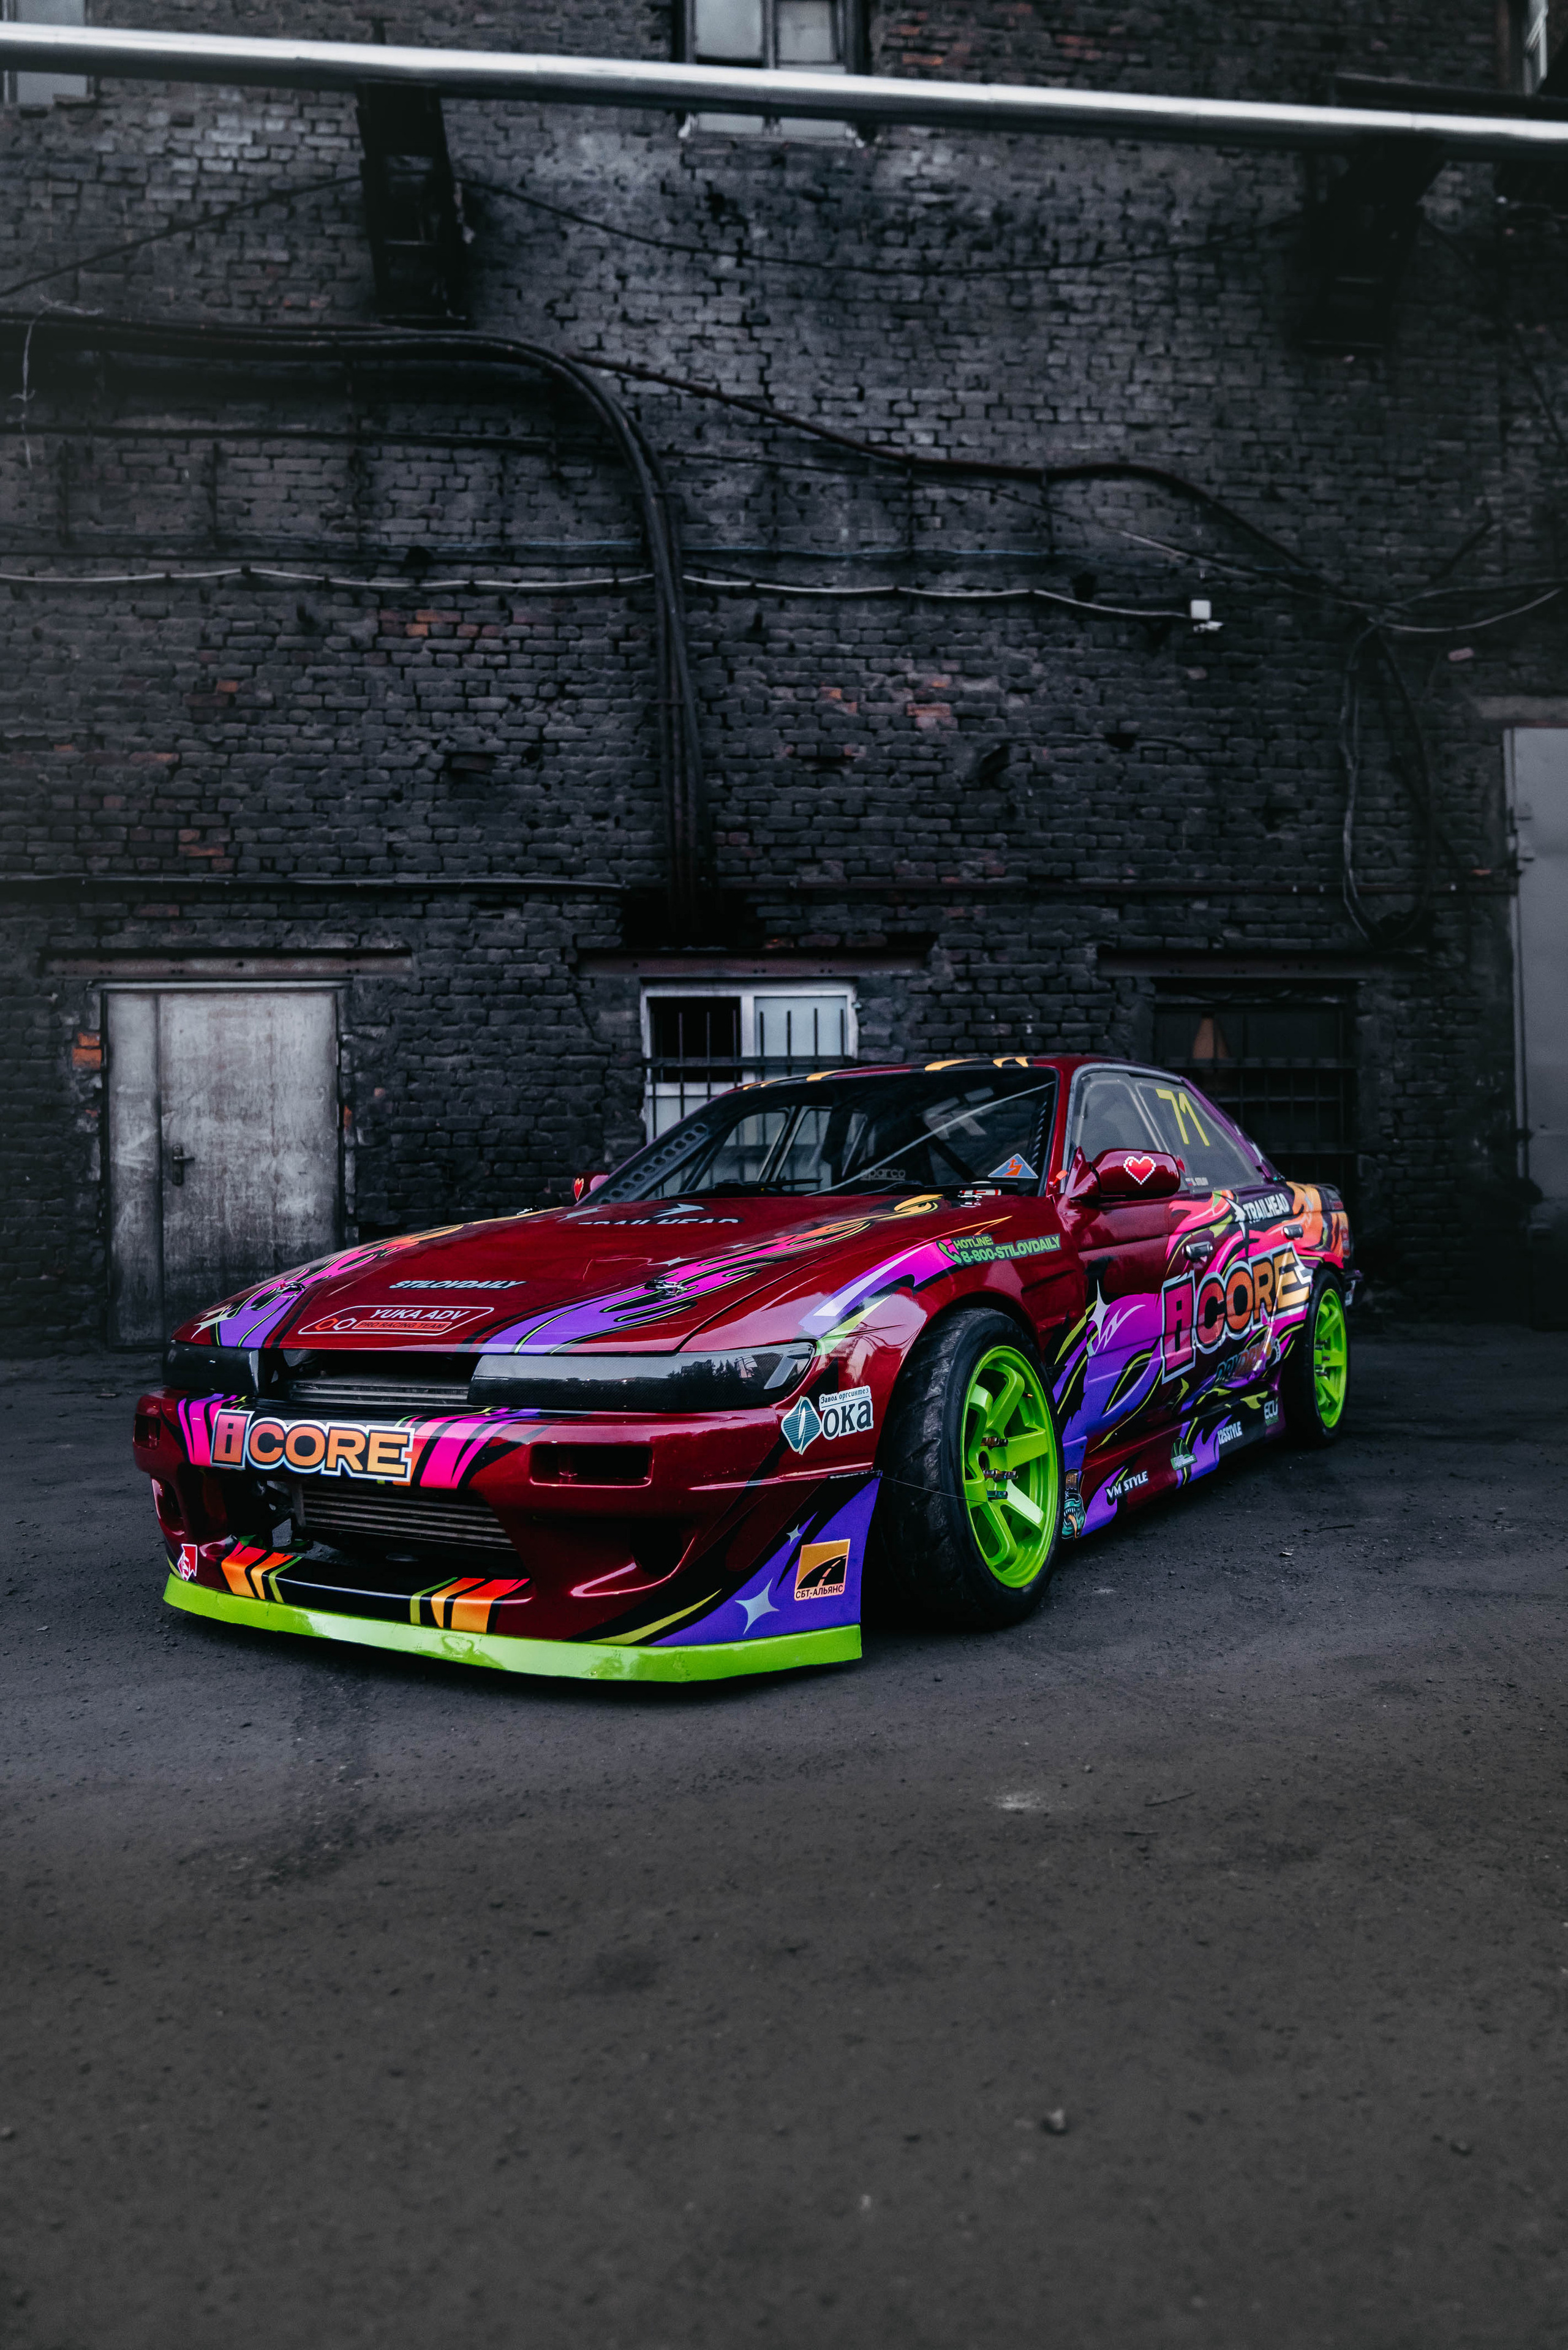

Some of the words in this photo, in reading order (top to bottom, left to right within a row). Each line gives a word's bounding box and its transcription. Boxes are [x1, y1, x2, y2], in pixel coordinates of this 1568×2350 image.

[1155, 1088, 1210, 1147] 71
[1242, 1192, 1290, 1224] TRAILHEAD
[953, 1236, 993, 1250] HOTLINE:
[960, 1236, 1060, 1263] 8-800-STILOVDAILY
[389, 1280, 526, 1289] STILOVDAILY
[369, 1309, 423, 1319] YUKA
[419, 1310, 471, 1320] ADV
[839, 1388, 869, 1401] оргсинтез
[1123, 1471, 1148, 1491] STYLE
[796, 1584, 843, 1599] СБТ-АЛЬЯНС
